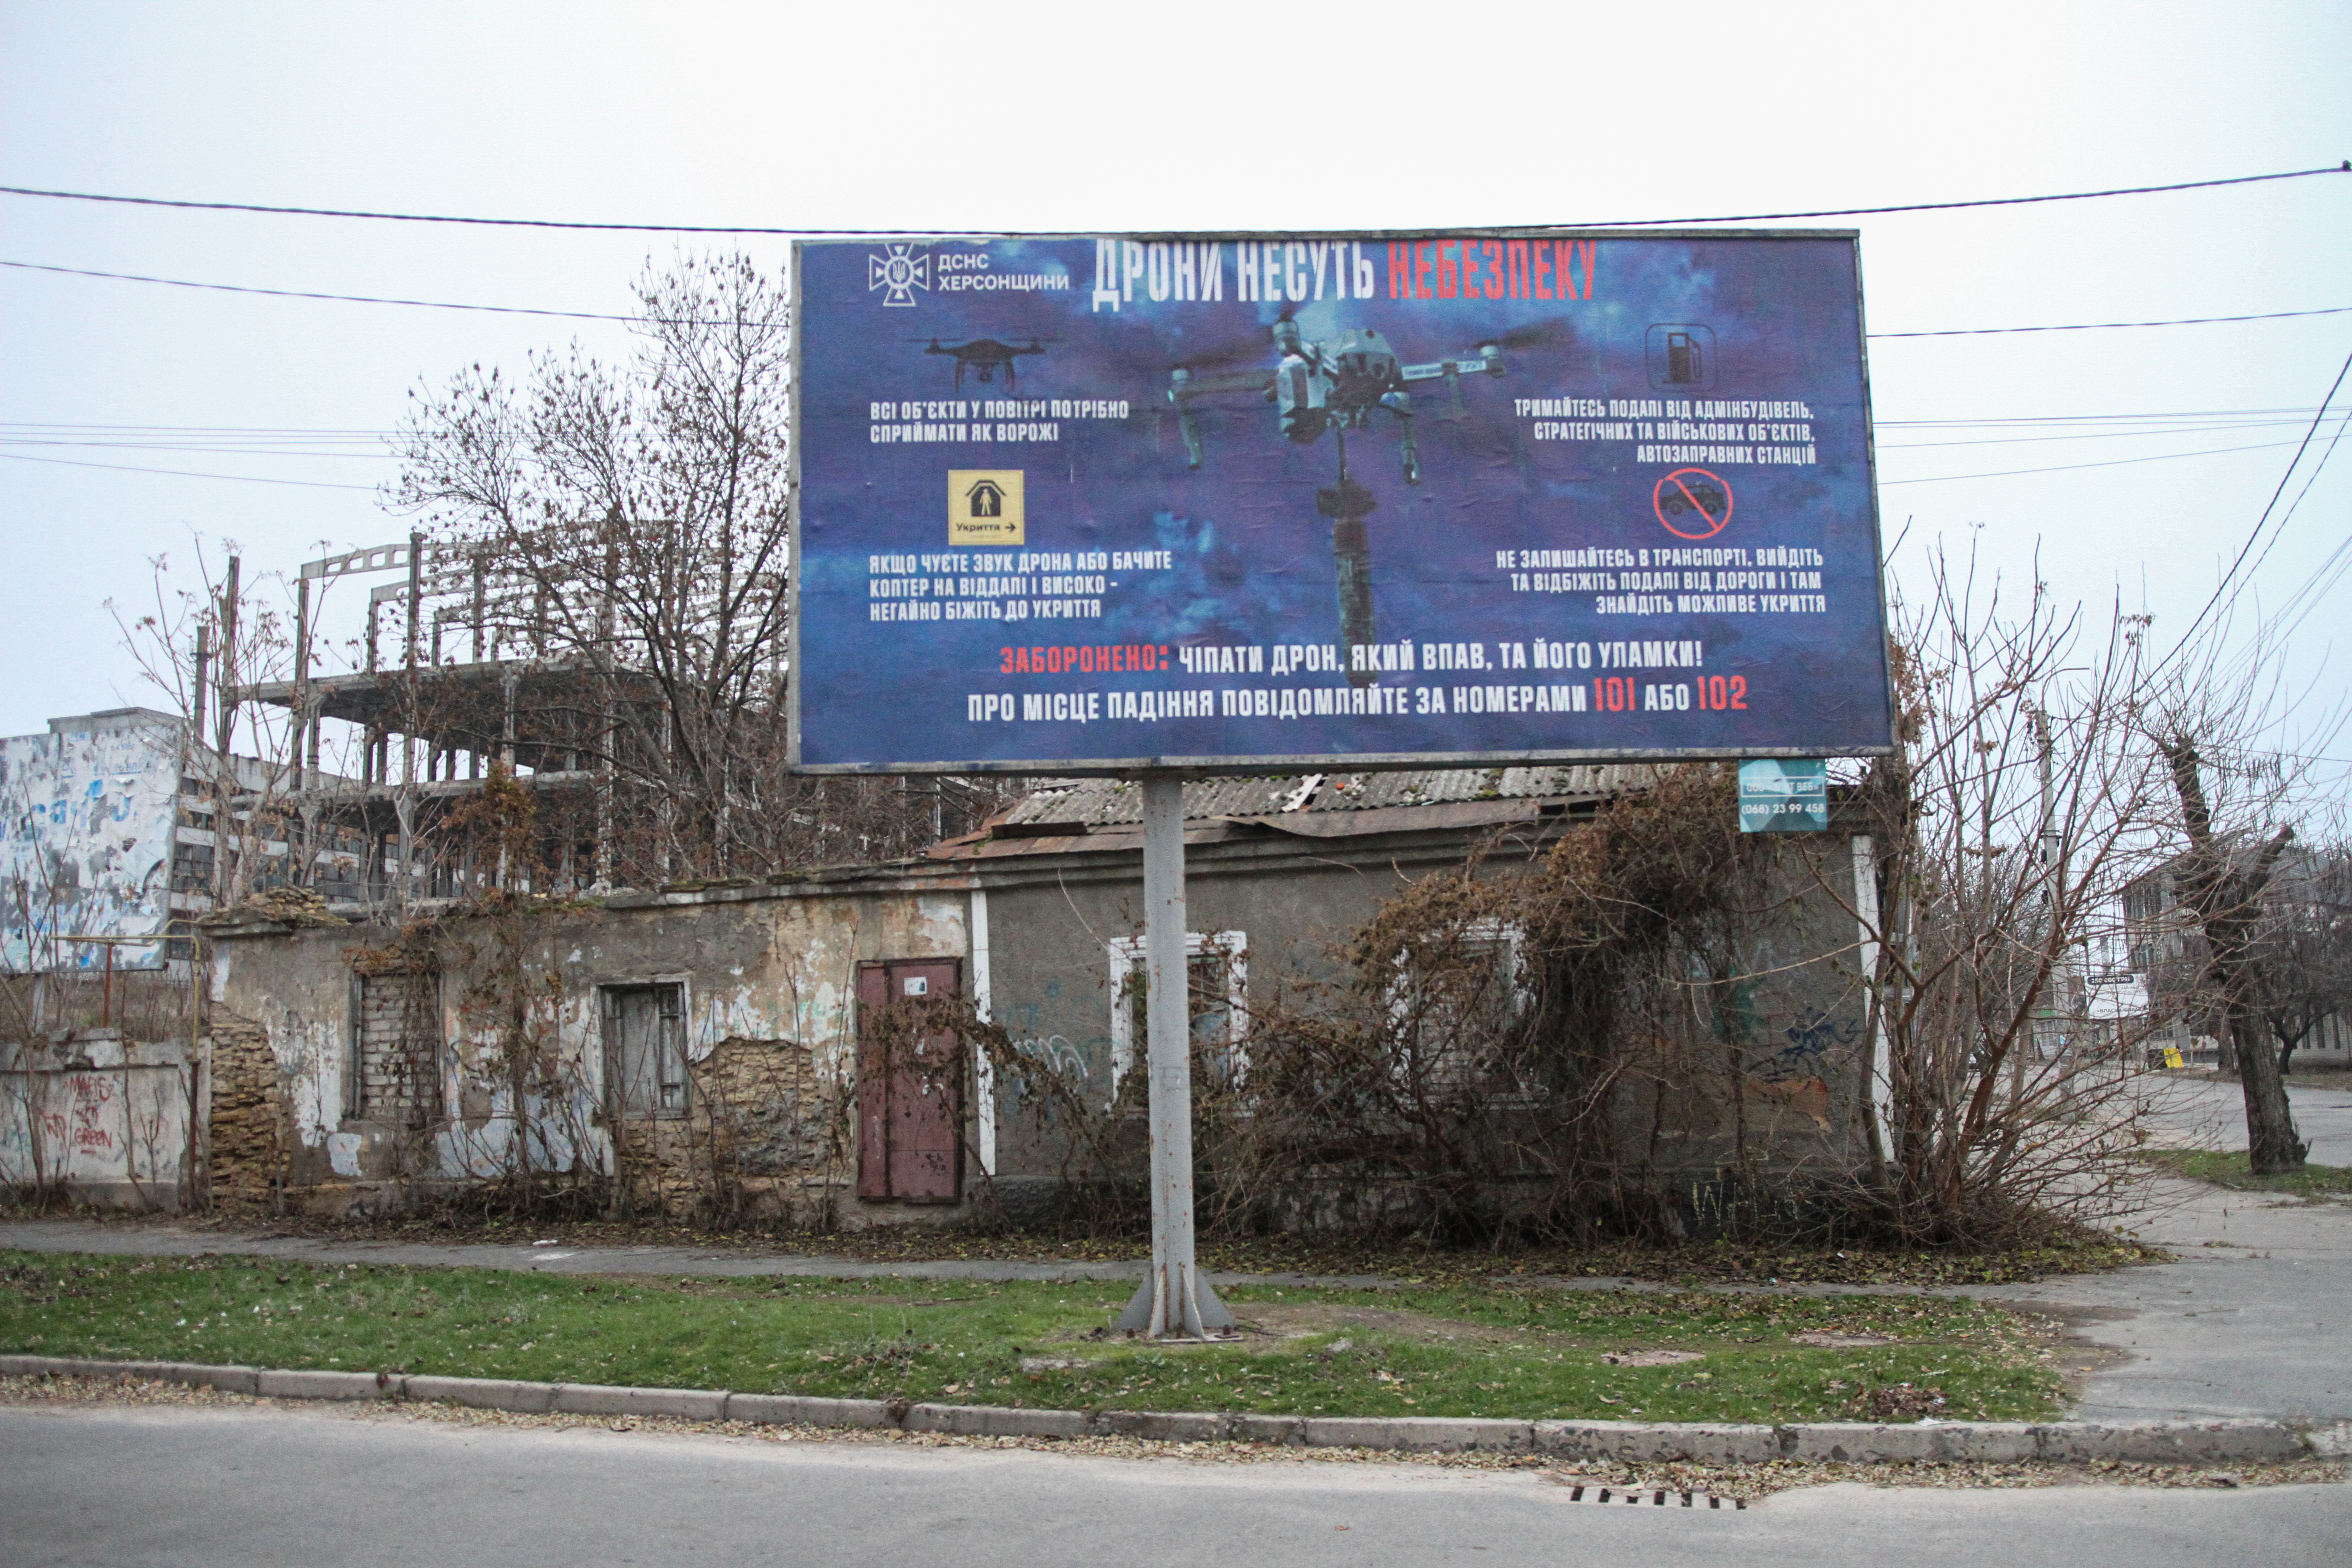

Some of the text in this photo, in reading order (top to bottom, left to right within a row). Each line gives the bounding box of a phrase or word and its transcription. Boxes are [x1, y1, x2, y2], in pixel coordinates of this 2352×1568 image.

[938, 254, 988, 271] ДСНС
[939, 274, 1069, 291] ХЕРСОНЩИНИ
[1092, 239, 1596, 312] ДРОНИ НЕСУТЬ НЕБЕЗПЕКУ
[871, 402, 896, 420] ВСІ
[971, 401, 980, 418] У
[985, 400, 1046, 418] ПОВІТРІ
[1051, 400, 1128, 418] ПОТРІБНО
[1515, 397, 1814, 420] ТРИМАЙТЕСЬ ПОДАЛІ ВІД АДМІНБУДІВЕЛЬ,
[871, 421, 1058, 442] СПРИЙМАТИ ЯК ВОРОЖІ
[1534, 422, 1633, 440] СТРАТЕГІЧНИХ
[1637, 421, 1653, 439] ТА
[1657, 419, 1744, 441] ВІЙСЬКОВИХ
[1637, 445, 1815, 466] АВТОЗАПРАВНИХ СТАНЦІЙ
[956, 523, 1000, 532] Укриття
[870, 551, 1171, 575] ЯКЩО ЧУЄТЕ ЗВУК ДРОНА АБО БАЧИТЕ
[1497, 546, 1823, 568] НЕ ЗАЛИШАЙТЕСЬ В ТРАНСПОРТІ, ВИЙДІТЬ
[870, 578, 929, 598] КОПТЕР
[934, 578, 954, 596] НА
[960, 577, 1026, 598] ВІДДАЛІ
[1032, 577, 1037, 594] І
[1042, 575, 1105, 594] ВИСОКО
[1511, 571, 1821, 592] ТА ВІДБІЖІТЬ ПОДАЛІ ВІД ДОРОГИ І ТАМ
[871, 599, 1100, 621] НЕГАЙНО БІЖІТЬ ДО УКРИТТЯ
[1596, 593, 1825, 615] ЗНАЙДІТЬ МОЖЛИВЕ УКРИТТЯ
[1000, 638, 1702, 676] ЗАБОРОНЕНО: ЧІПАТИ ДРОН, ЯКИЙ ВПАВ, ТА ЙОГО УЛАМКИ!
[968, 675, 1747, 723] ПРО МІСЦЕ ПАДІННЯ ПОВІДОМЛЯЙТЕ ЗА НОМЕРАМИ 101 АБО 102
[1741, 803, 1825, 815] (068) 23 99 458
